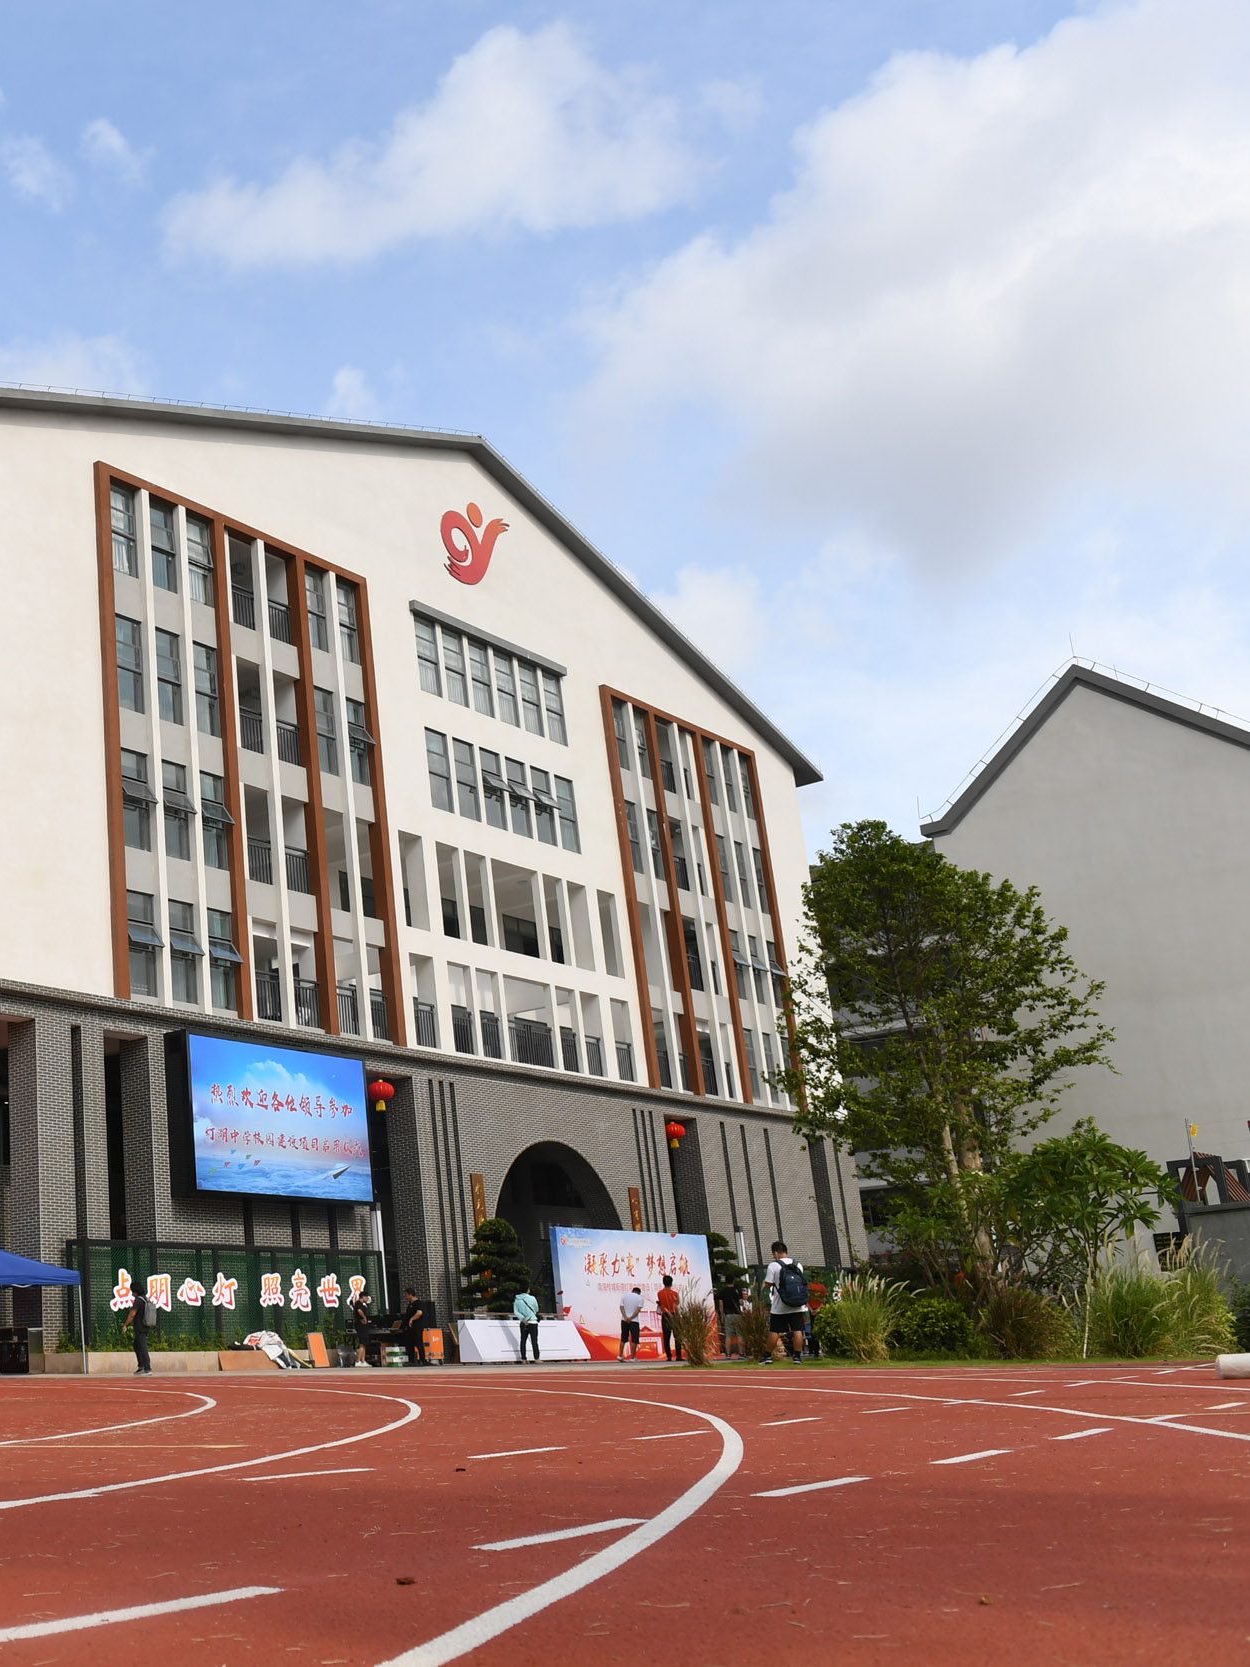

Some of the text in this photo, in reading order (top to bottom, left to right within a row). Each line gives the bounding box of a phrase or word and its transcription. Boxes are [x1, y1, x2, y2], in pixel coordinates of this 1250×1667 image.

[210, 1083, 353, 1119] 热烈欢迎各位领导参加
[205, 1127, 365, 1158] 灯湖中学校园建设项目启用仪式
